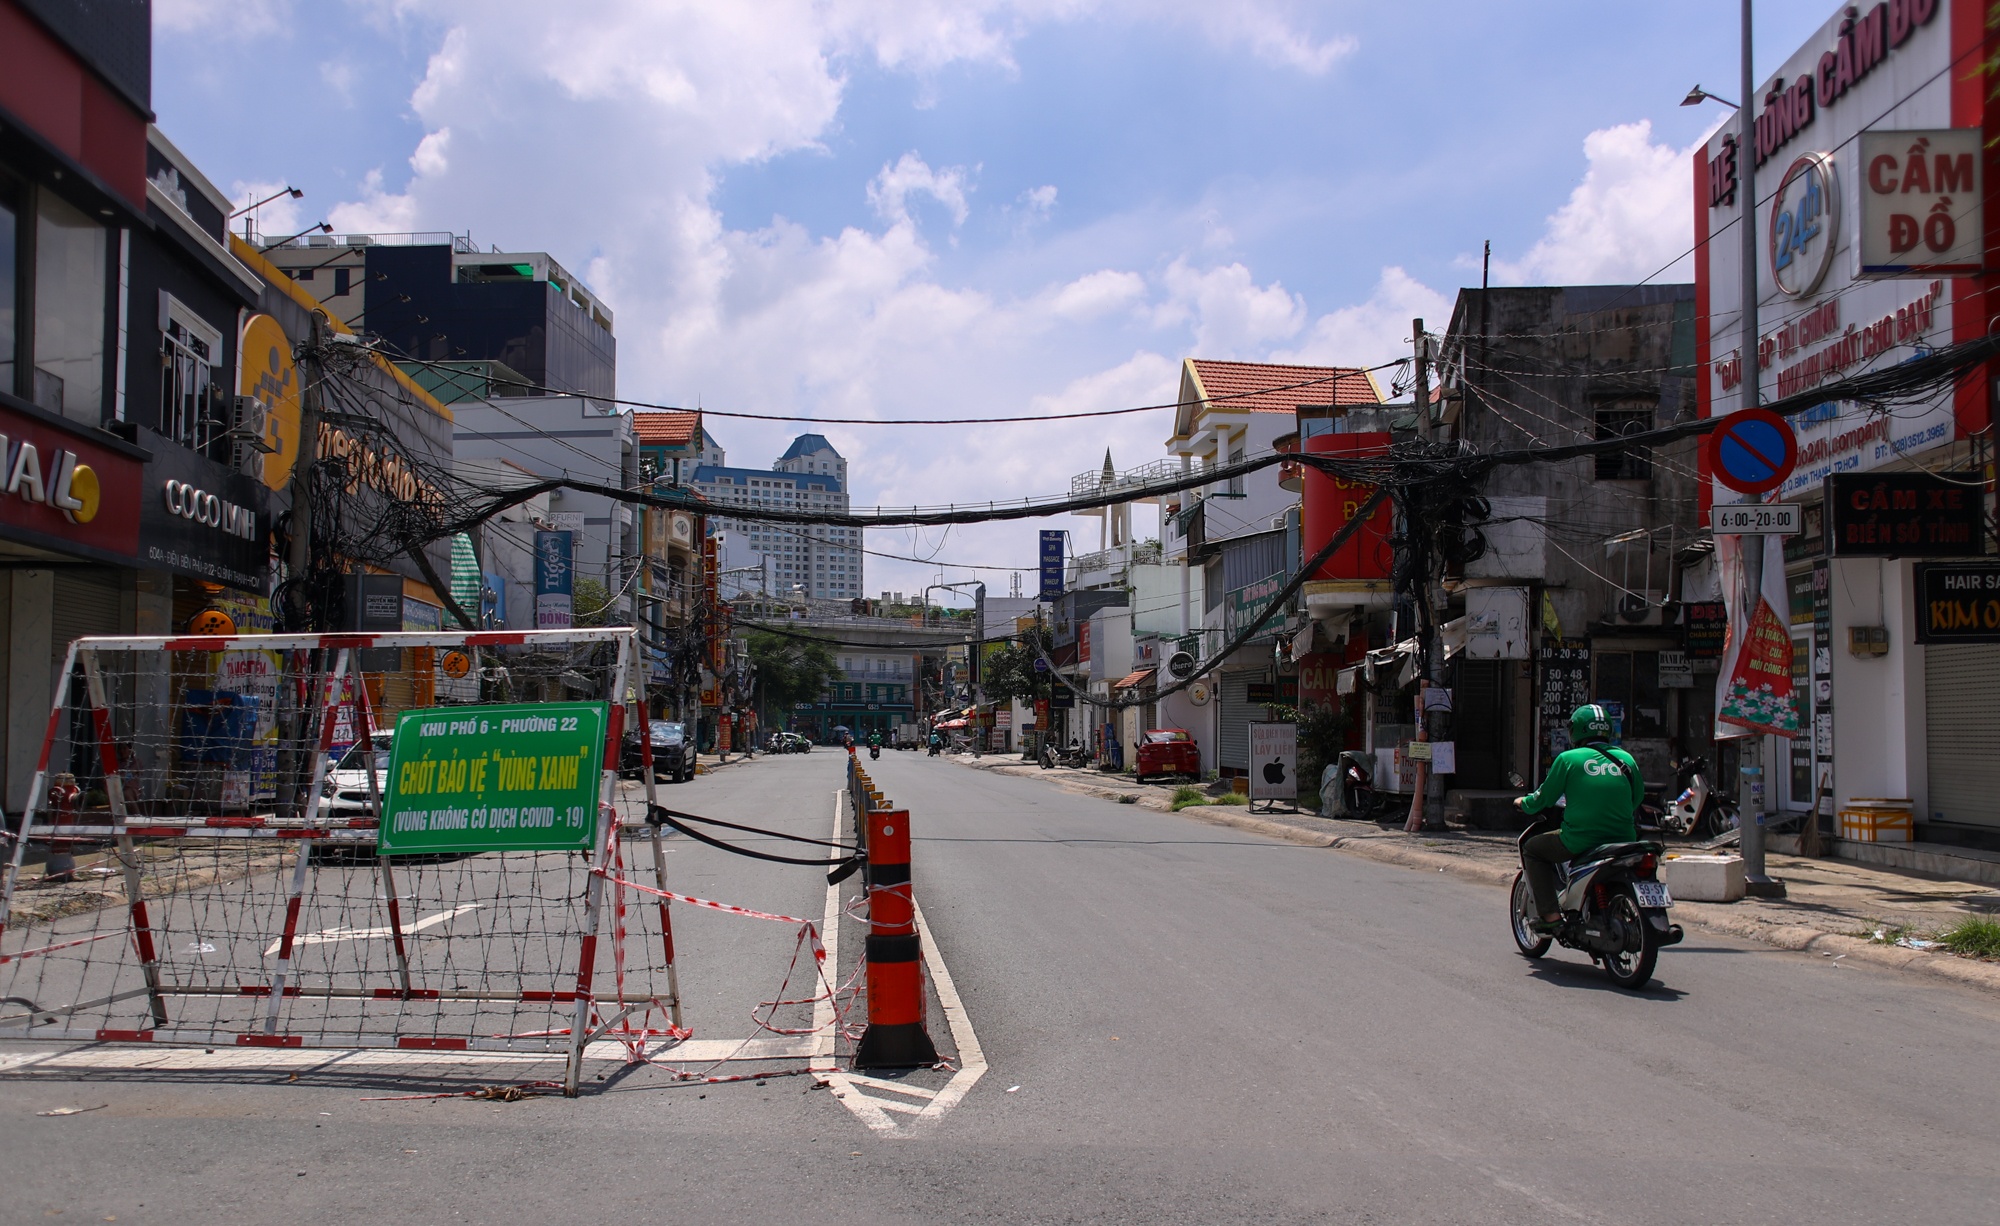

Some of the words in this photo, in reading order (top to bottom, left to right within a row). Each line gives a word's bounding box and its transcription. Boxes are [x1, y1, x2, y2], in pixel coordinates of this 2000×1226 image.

[1709, 133, 1737, 207] HỆ
[1868, 137, 1974, 195] CẦM
[1776, 168, 1821, 272] 24h
[1888, 197, 1956, 254] ĐỒ
[1862, 314, 1893, 357] CHO
[1834, 455, 1859, 473] TP.HCM
[1927, 488, 1965, 510] XE
[166, 480, 220, 528] COCO
[222, 500, 256, 542] LYNH
[1721, 512, 1791, 527] 6:00-20:00
[149, 546, 164, 561] 604A
[1945, 575, 1981, 590] HAIR
[1930, 599, 1980, 631] KIM
[1542, 648, 1553, 658] 10
[1560, 648, 1571, 659] 20
[1578, 649, 1589, 659] 30
[1549, 669, 1561, 679] 50
[1570, 669, 1582, 679] 48
[1546, 681, 1563, 692] 100
[795, 702, 812, 710] GS25
[1544, 692, 1560, 702] 200
[1543, 704, 1560, 714] 300
[420, 722, 446, 737] KHU
[450, 715, 476, 736] PHỐ
[480, 720, 489, 734] 6
[501, 716, 557, 733] PHƯỜNG
[560, 717, 578, 732] 22
[1588, 721, 1610, 732] Grab
[400, 748, 436, 795] CHỐT
[437, 748, 467, 793] BẢO
[469, 752, 488, 800] VỆ
[393, 806, 427, 833] (VÙNG
[429, 808, 468, 831] KHÔNG
[471, 804, 487, 830] CÓ
[489, 807, 516, 833] DỊCH
[519, 806, 554, 828] COVID
[566, 806, 583, 829] 19)
